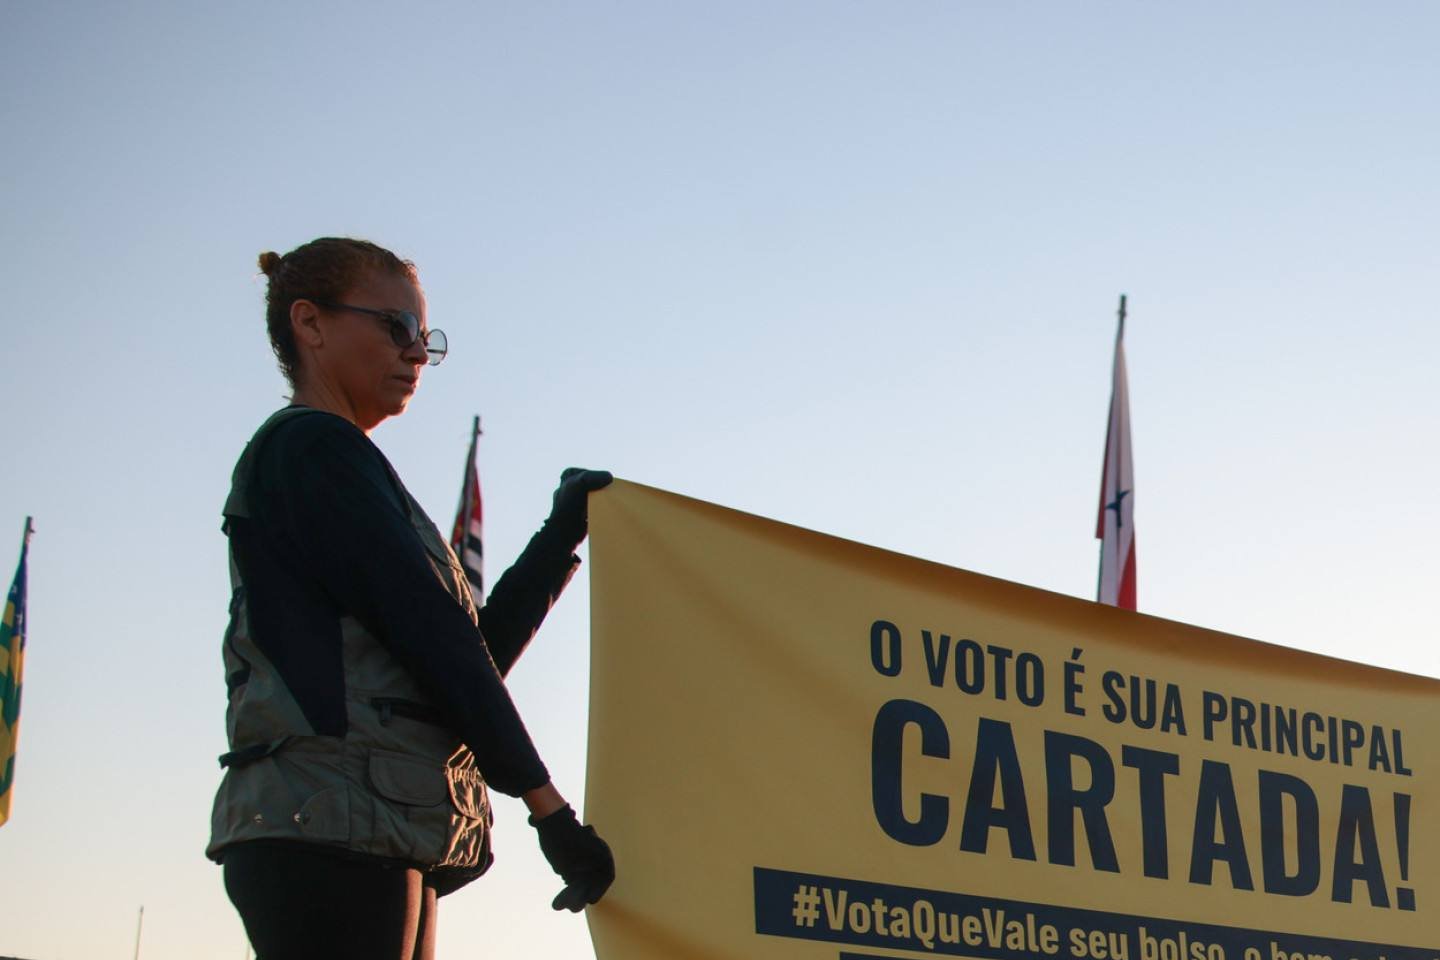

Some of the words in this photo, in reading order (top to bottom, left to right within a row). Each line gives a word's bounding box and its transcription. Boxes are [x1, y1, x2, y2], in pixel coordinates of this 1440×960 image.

[870, 620, 902, 677] O
[921, 630, 1044, 707] VOTO
[1064, 647, 1085, 716] É
[1102, 670, 1187, 736] SUA
[1203, 690, 1413, 777] PRINCIPAL
[871, 699, 1416, 912] CARTADA!
[792, 884, 1059, 955] #VotaQueVale
